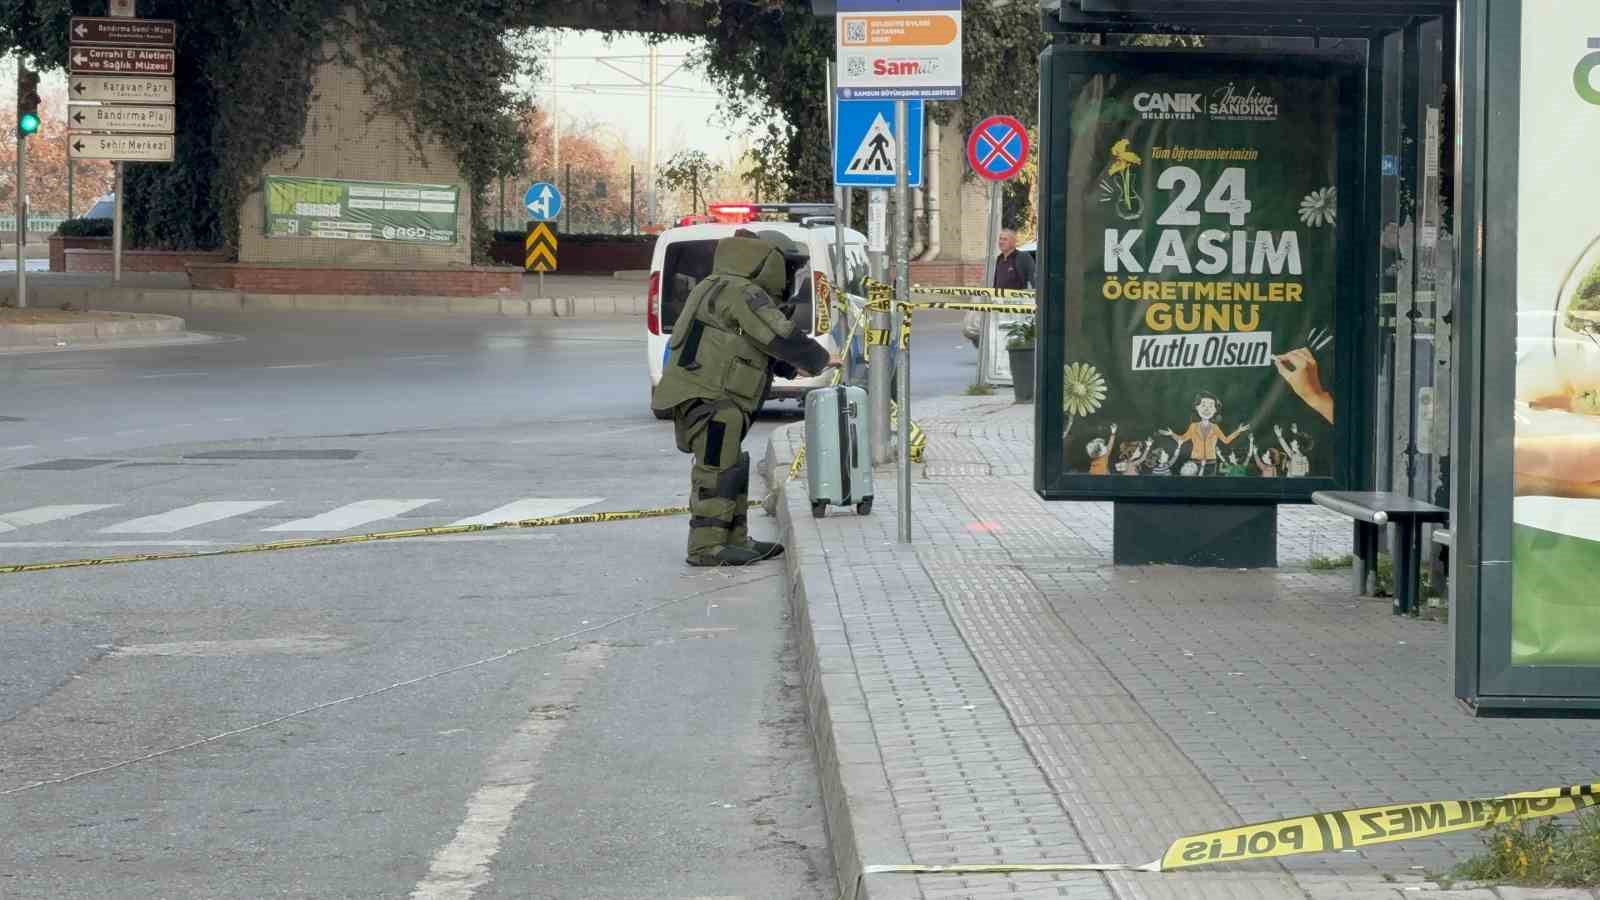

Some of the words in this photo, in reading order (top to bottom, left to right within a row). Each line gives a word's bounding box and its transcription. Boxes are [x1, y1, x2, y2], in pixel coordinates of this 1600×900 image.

[89, 49, 123, 58] Cerrahi
[127, 50, 136, 59] El
[103, 60, 132, 71] Sağlık
[135, 61, 168, 70] Müzesi
[103, 82, 142, 91] Karavan
[146, 82, 168, 92] Park
[97, 109, 146, 120] Bandırma
[1209, 103, 1278, 117] SANDIKÇI
[100, 139, 126, 150] Şehir
[129, 140, 167, 150] Merkezi
[1151, 147, 1170, 160] Tüm
[1171, 146, 1259, 161] Öğretmenlerimizin
[1156, 166, 1252, 226] 24
[1103, 228, 1303, 275] KASIM
[1102, 276, 1303, 302] ÖĞRETMENLER
[1145, 303, 1261, 332] GÜNÜ
[1136, 337, 1200, 369] Kutlu
[1202, 336, 1268, 367] Olsun
